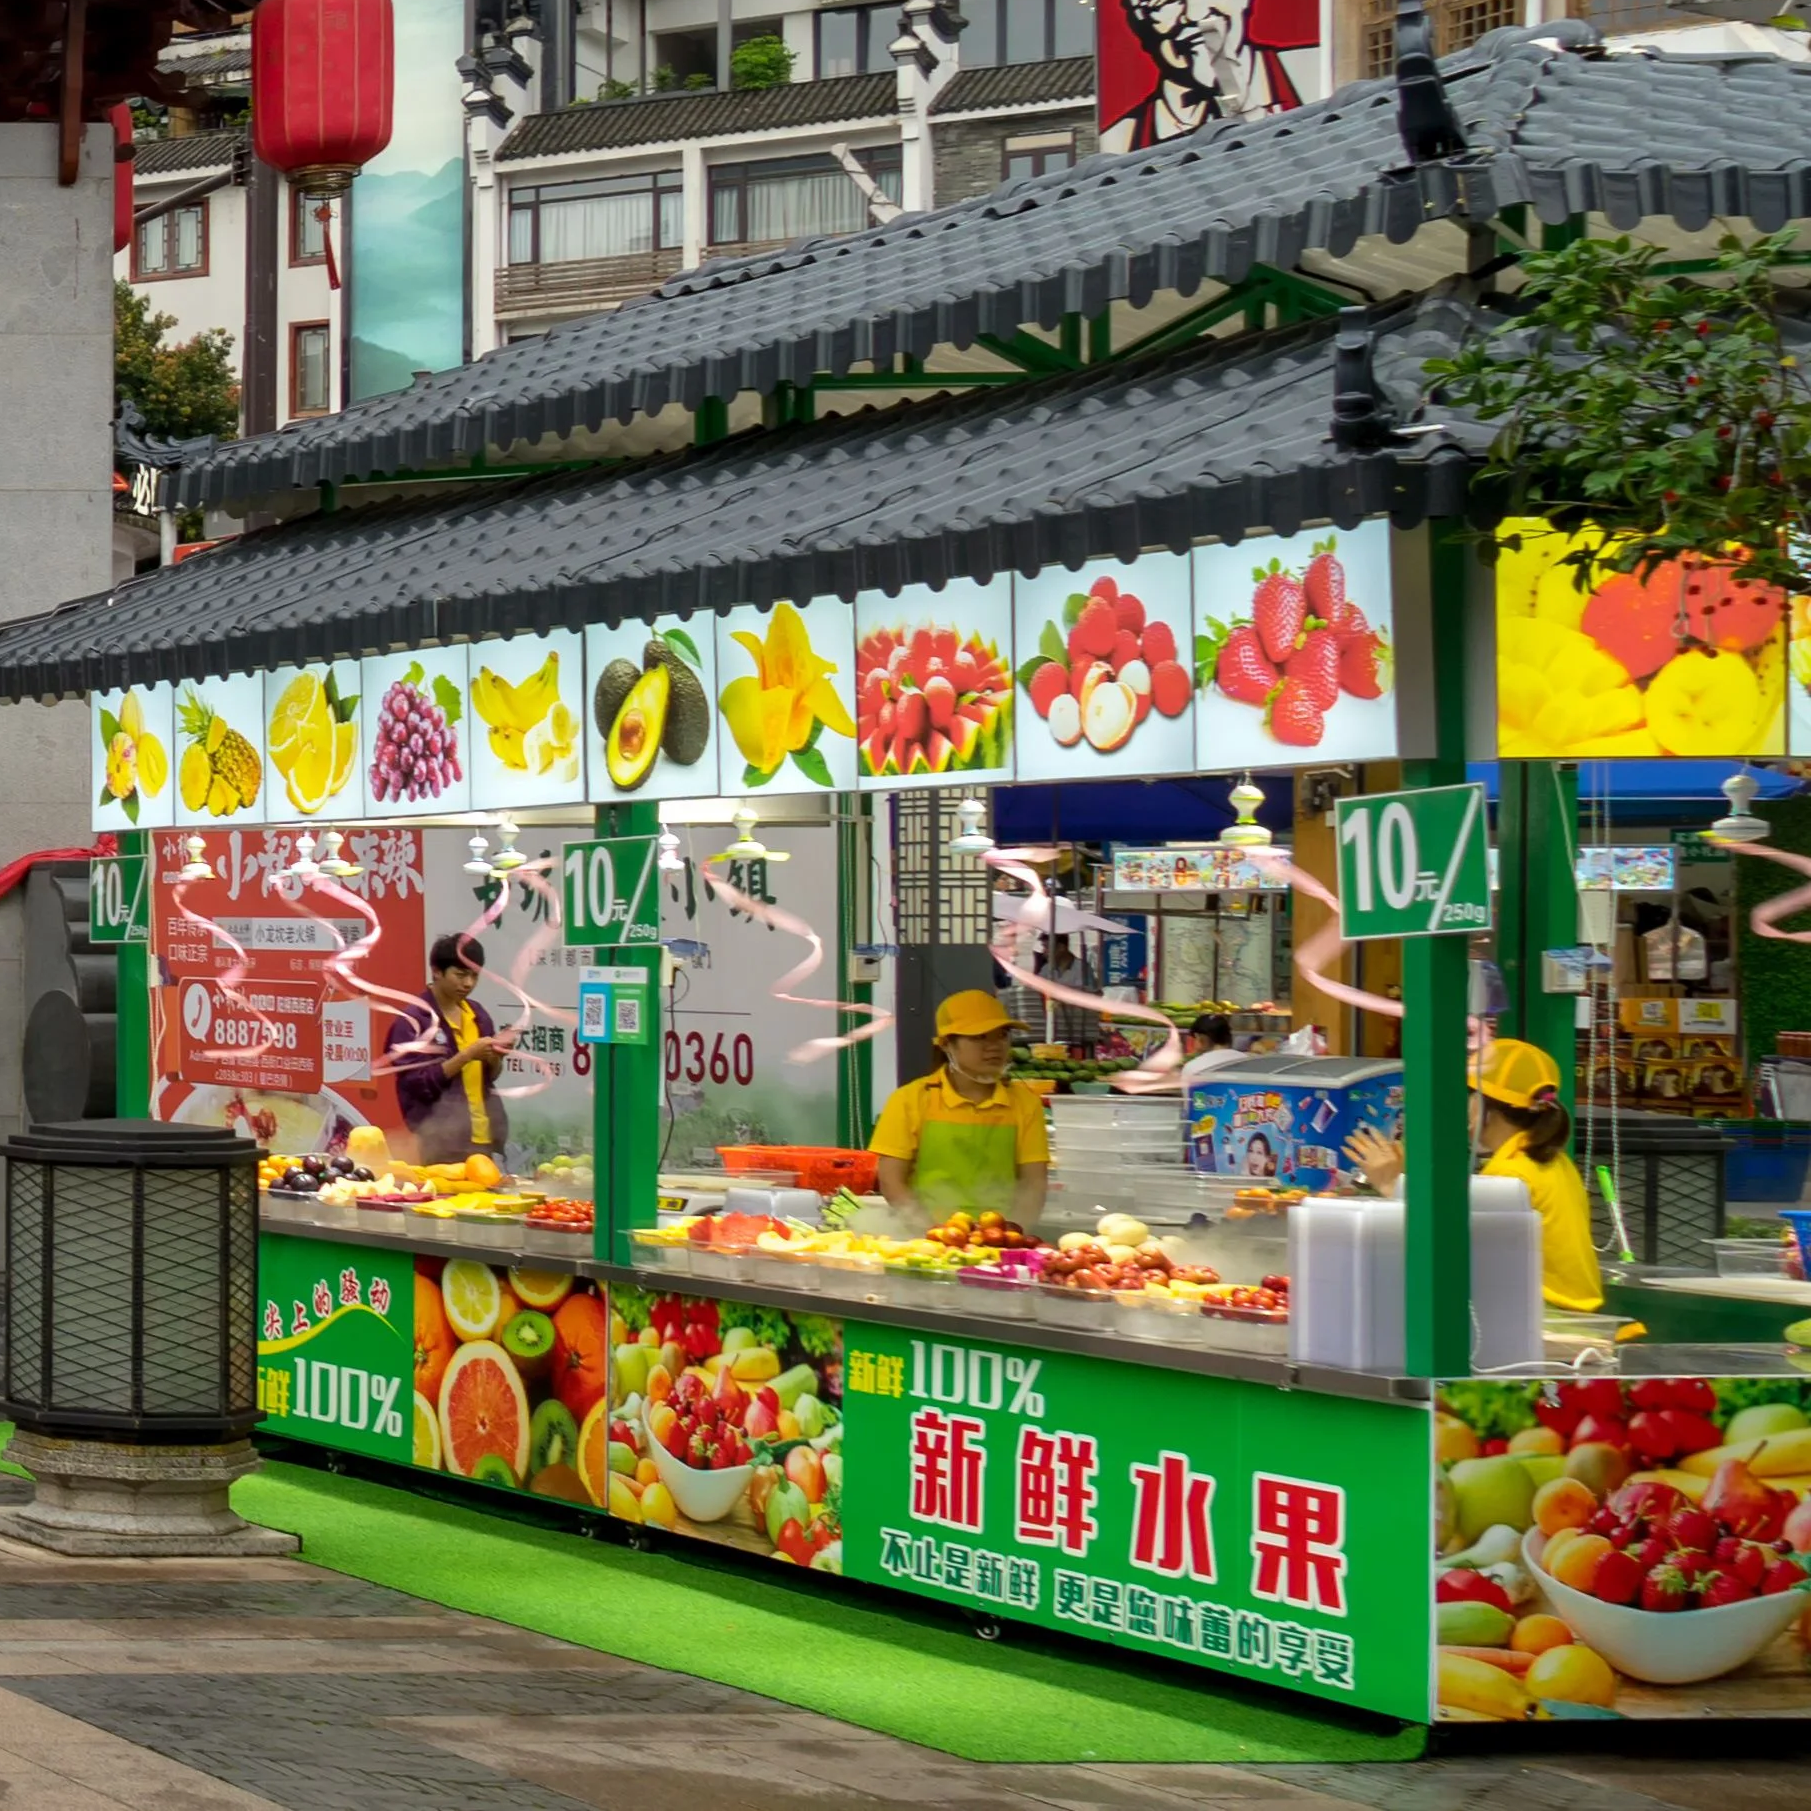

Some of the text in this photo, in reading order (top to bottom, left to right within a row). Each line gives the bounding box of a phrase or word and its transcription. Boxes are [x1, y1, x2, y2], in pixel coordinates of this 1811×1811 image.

[214, 1018, 297, 1050] 8887598
[292, 1357, 403, 1438] 100%
[908, 1340, 1045, 1419] 100%
[909, 1407, 1348, 1615] 新鲜水果
[881, 1528, 1354, 1691] 不止是新鲜 更是您味蕾的享受
